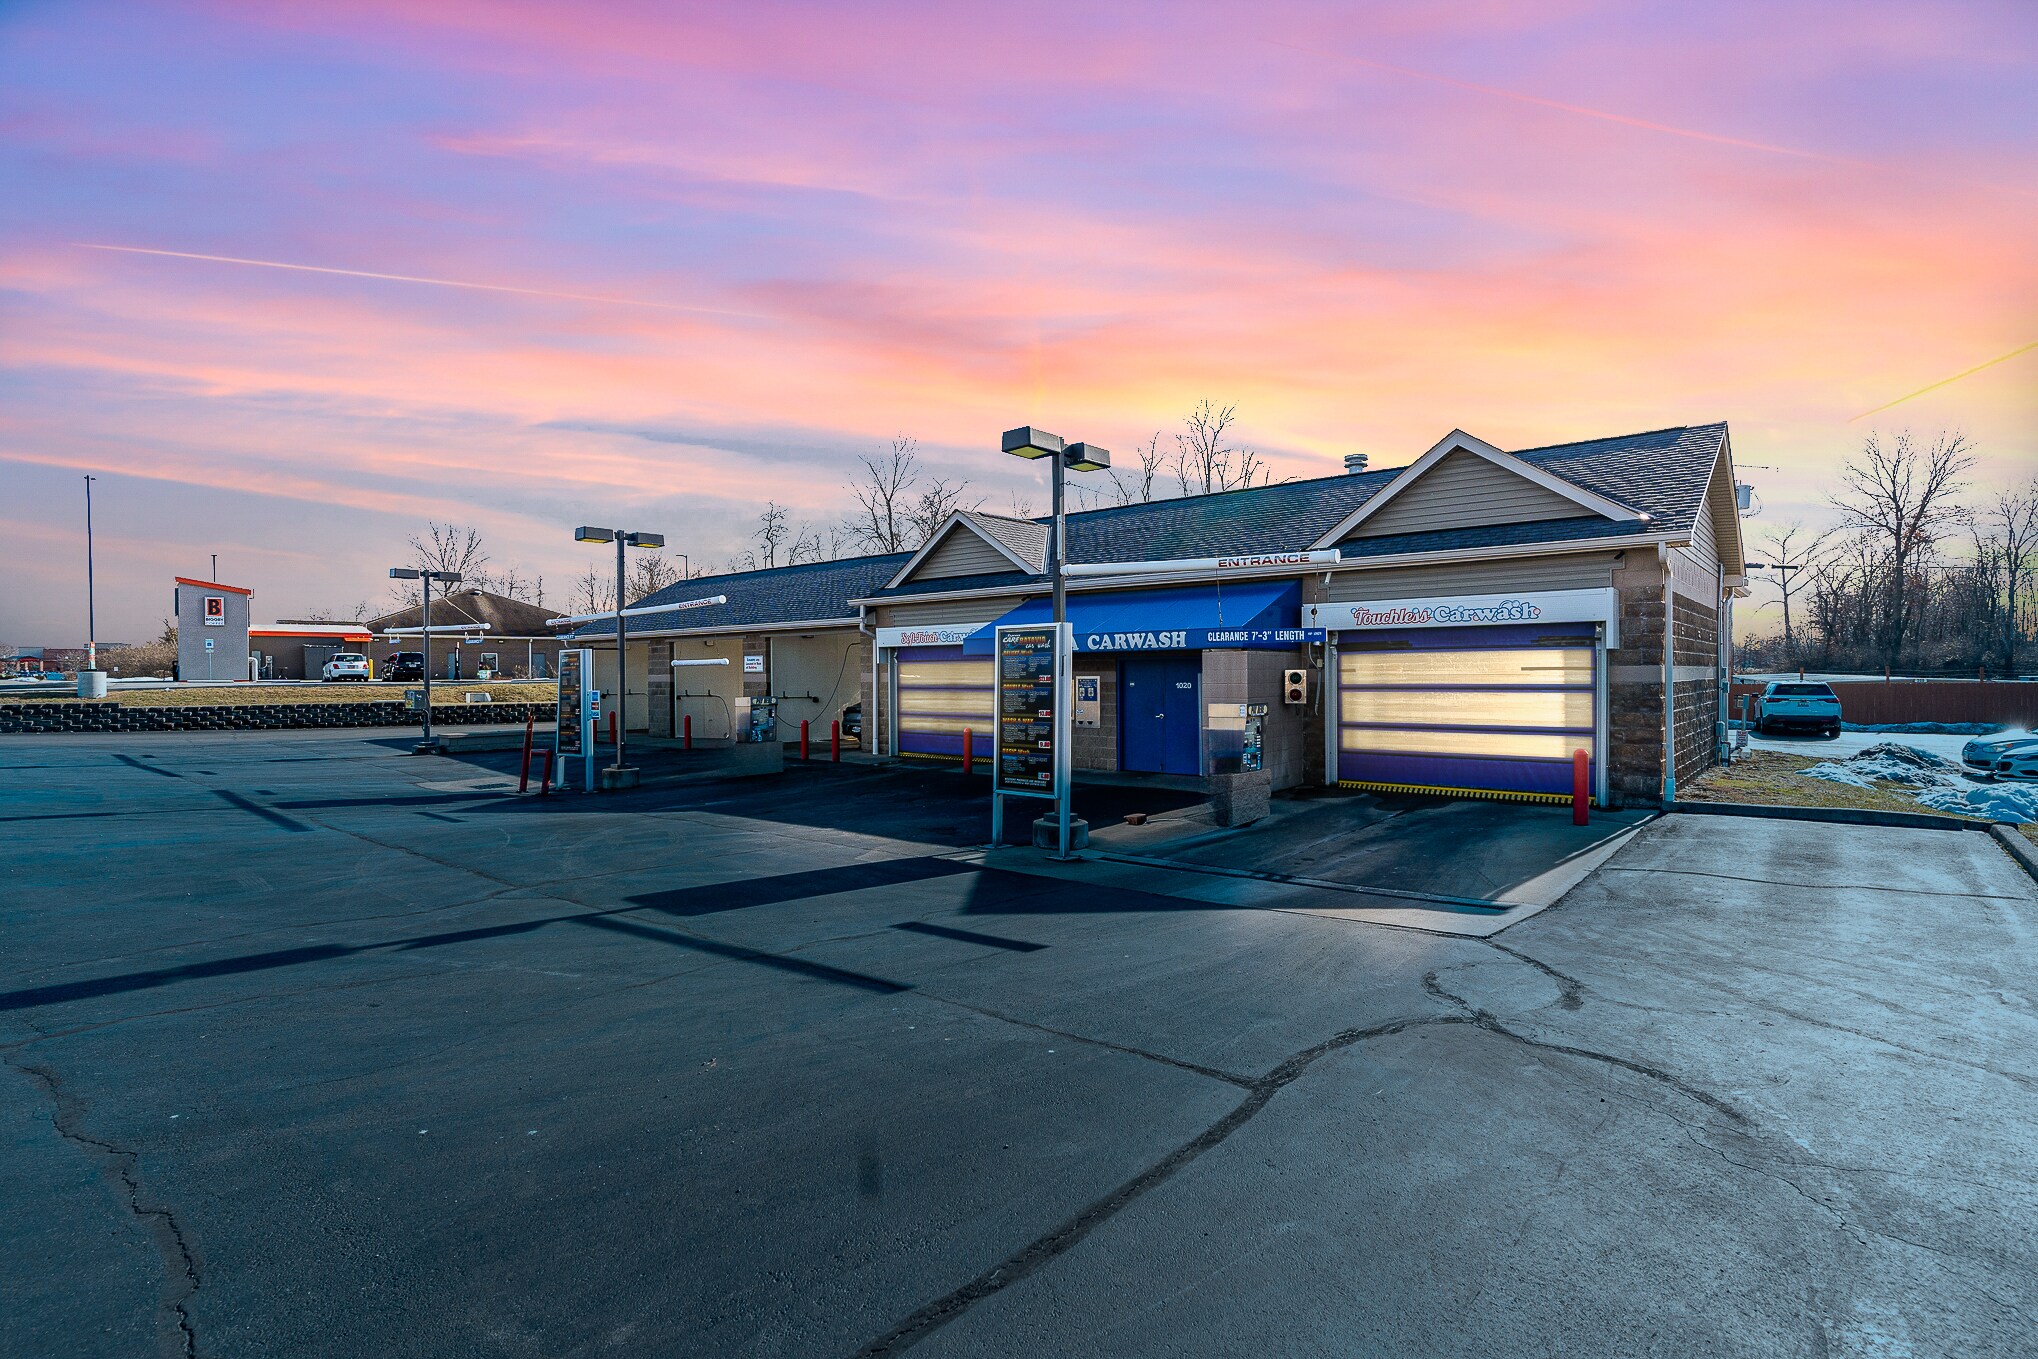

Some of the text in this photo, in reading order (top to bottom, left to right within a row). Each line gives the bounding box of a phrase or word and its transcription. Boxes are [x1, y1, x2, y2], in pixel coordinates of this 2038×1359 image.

[1218, 553, 1310, 568] ENTRANCE
[209, 599, 220, 615] B
[678, 598, 712, 609] ENTRANCE
[1352, 601, 1540, 625] Touchless Carwash
[1087, 631, 1187, 651] CARWASH
[1207, 631, 1249, 642] CLEARANCE
[1275, 630, 1305, 641] LENGTH
